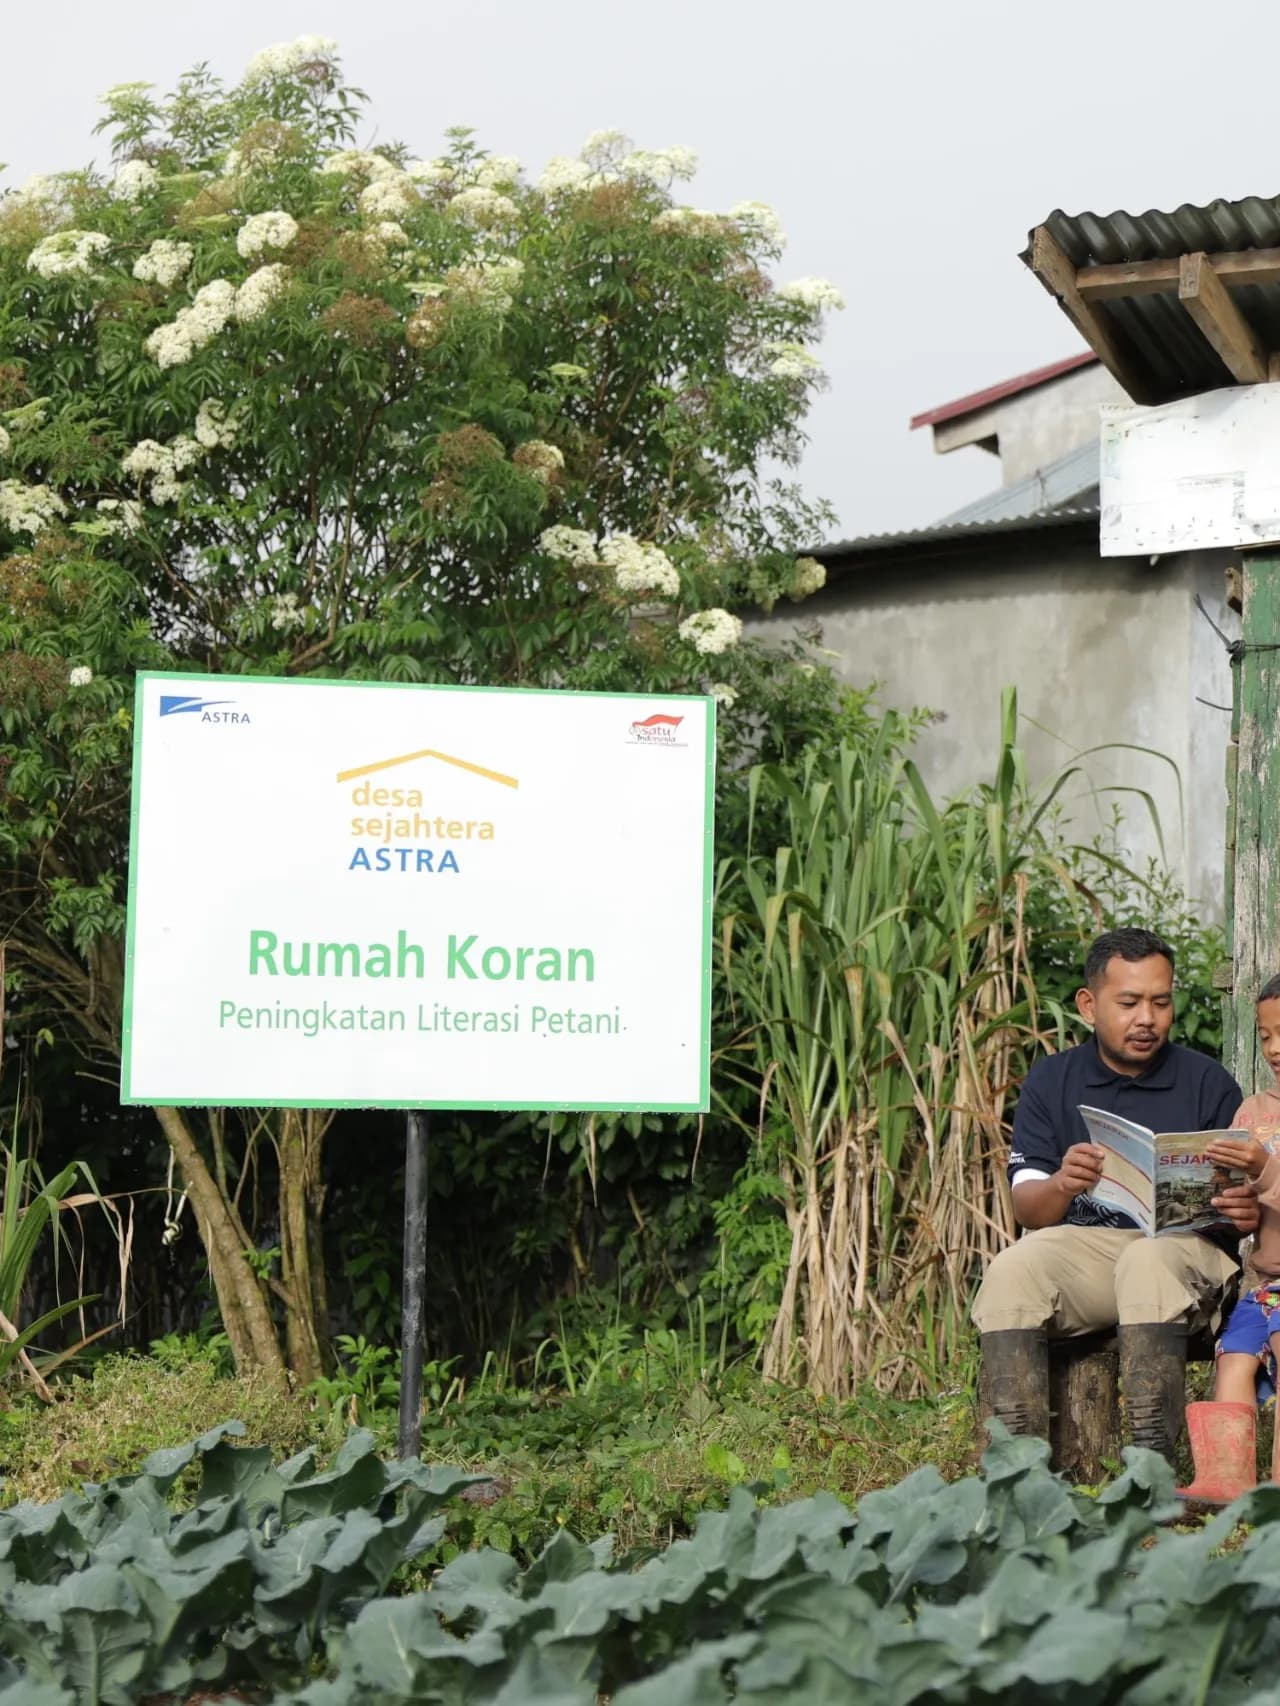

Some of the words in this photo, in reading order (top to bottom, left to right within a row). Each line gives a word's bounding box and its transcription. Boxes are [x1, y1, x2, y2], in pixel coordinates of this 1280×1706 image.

[201, 711, 251, 724] ASTRA
[351, 780, 424, 808] desa
[351, 812, 495, 844] sejahtera
[348, 846, 461, 873] ASTRA
[249, 929, 425, 978] Rumah
[447, 934, 595, 982] Koran
[218, 1000, 405, 1037] Peningkatan
[418, 1003, 519, 1032] Literasi
[531, 1005, 620, 1034] Petani
